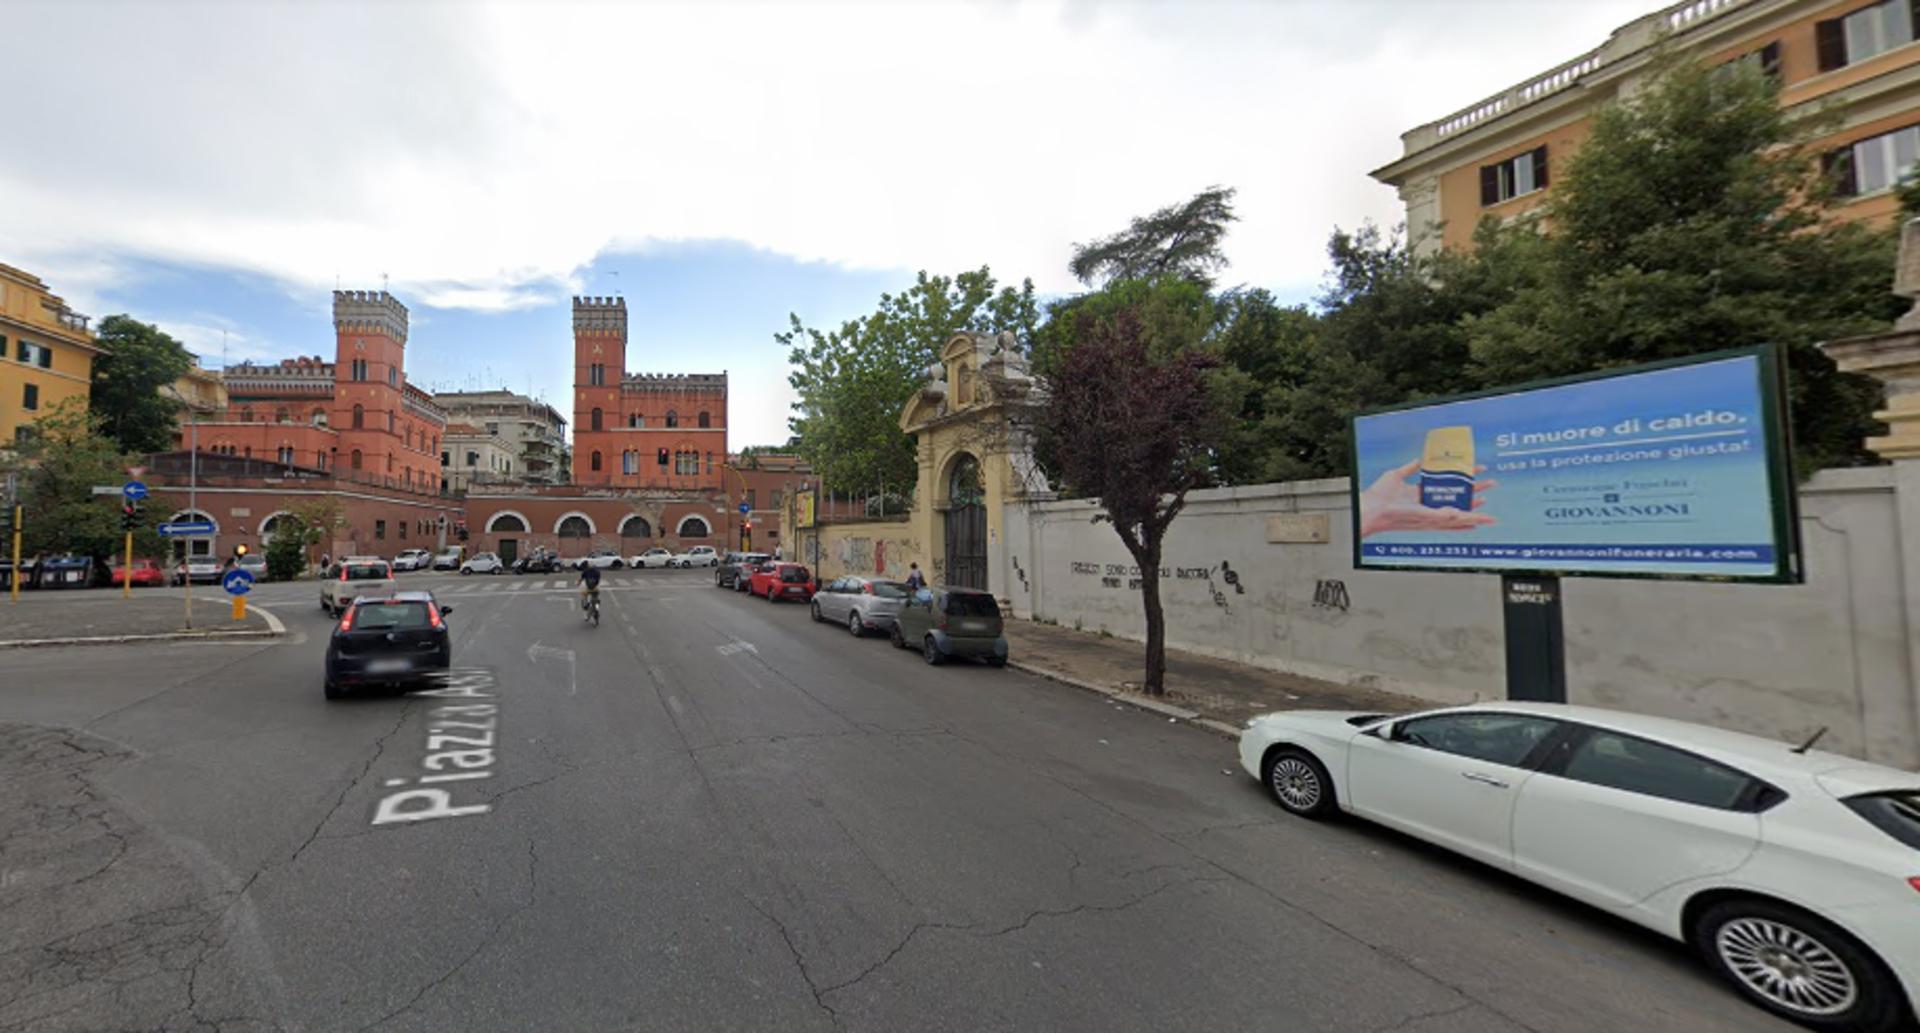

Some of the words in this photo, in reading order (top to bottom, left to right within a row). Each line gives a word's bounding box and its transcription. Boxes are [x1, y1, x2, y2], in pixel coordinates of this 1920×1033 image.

[1496, 433, 1516, 447] Si
[1523, 424, 1606, 444] muore
[1613, 418, 1640, 436] di
[1648, 410, 1747, 431] caldo.
[1496, 460, 1527, 471] usa
[1531, 457, 1547, 469] la
[1551, 449, 1662, 469] protezione
[1667, 439, 1751, 459] giusta!
[1544, 503, 1689, 519] GIOVANNONI
[1480, 547, 1758, 560] www.giovannonifuneraria.com
